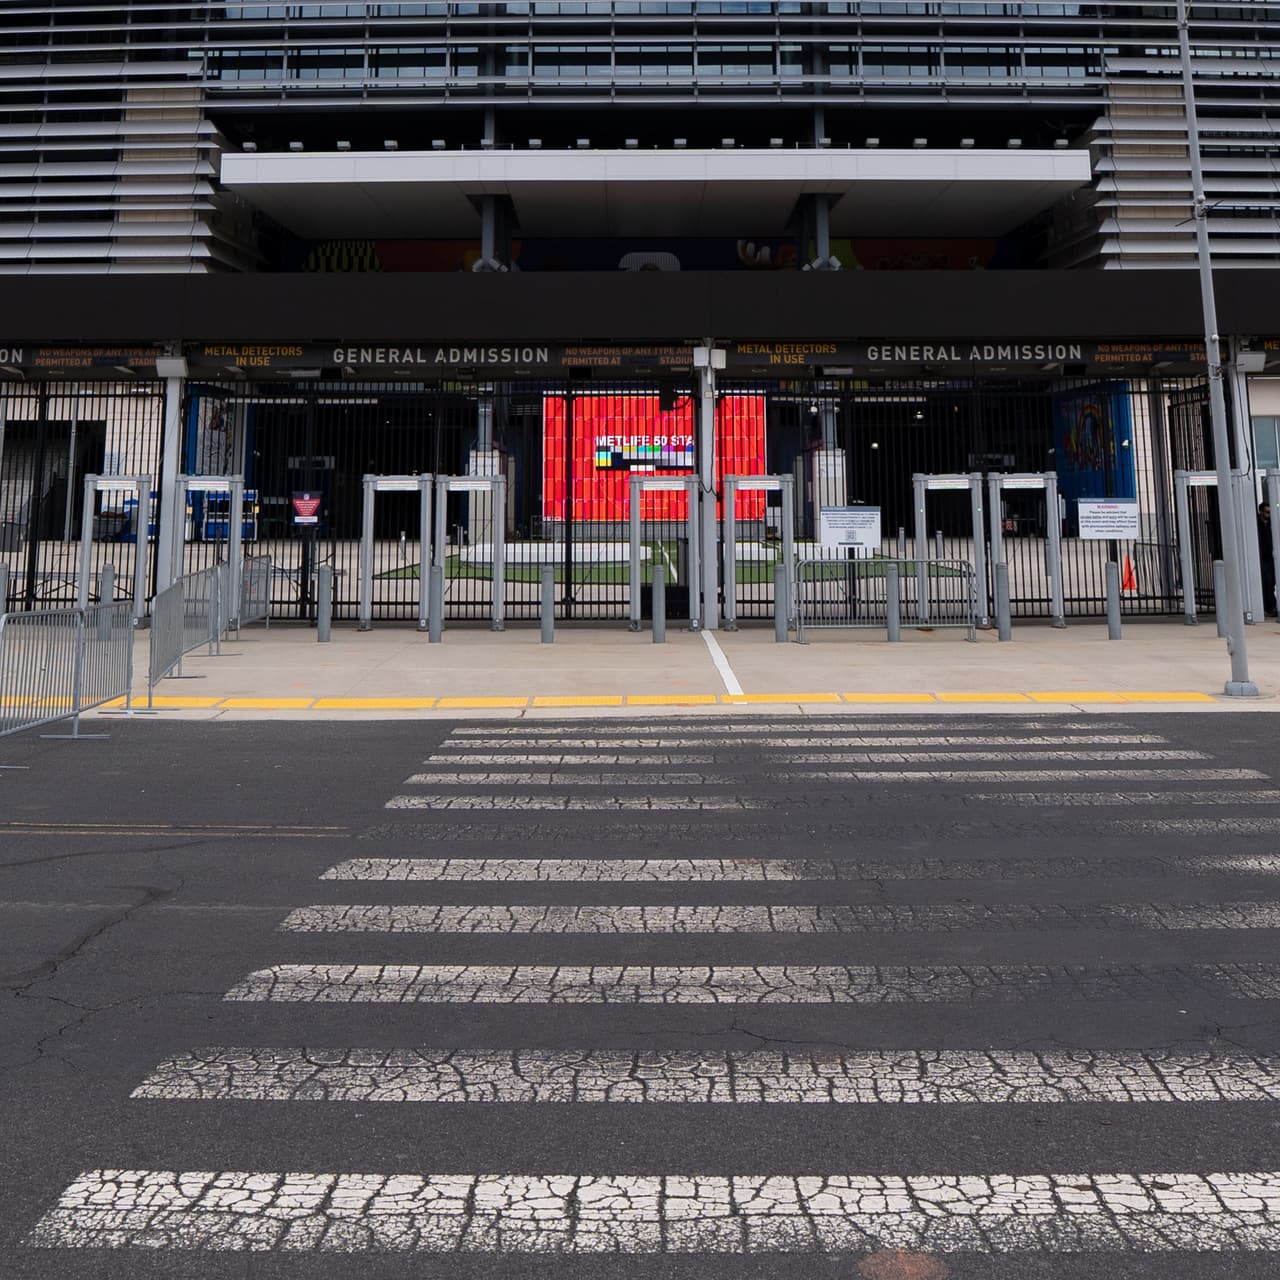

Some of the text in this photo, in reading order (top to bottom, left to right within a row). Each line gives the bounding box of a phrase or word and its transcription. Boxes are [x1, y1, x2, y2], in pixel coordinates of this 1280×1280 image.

[205, 346, 303, 356] METAL DETECTORS
[737, 344, 837, 354] METAL DETECTORS
[867, 344, 1082, 361] GENERAL ADMISSION
[333, 348, 548, 363] GENERAL ADMISSION
[769, 355, 806, 364] IN USE
[1094, 353, 1226, 362] PERMITTED AT STAM
[236, 357, 270, 366] IN USE
[561, 357, 609, 365] PERMITTED
[611, 357, 621, 365] AT
[596, 435, 650, 447] METLIFE
